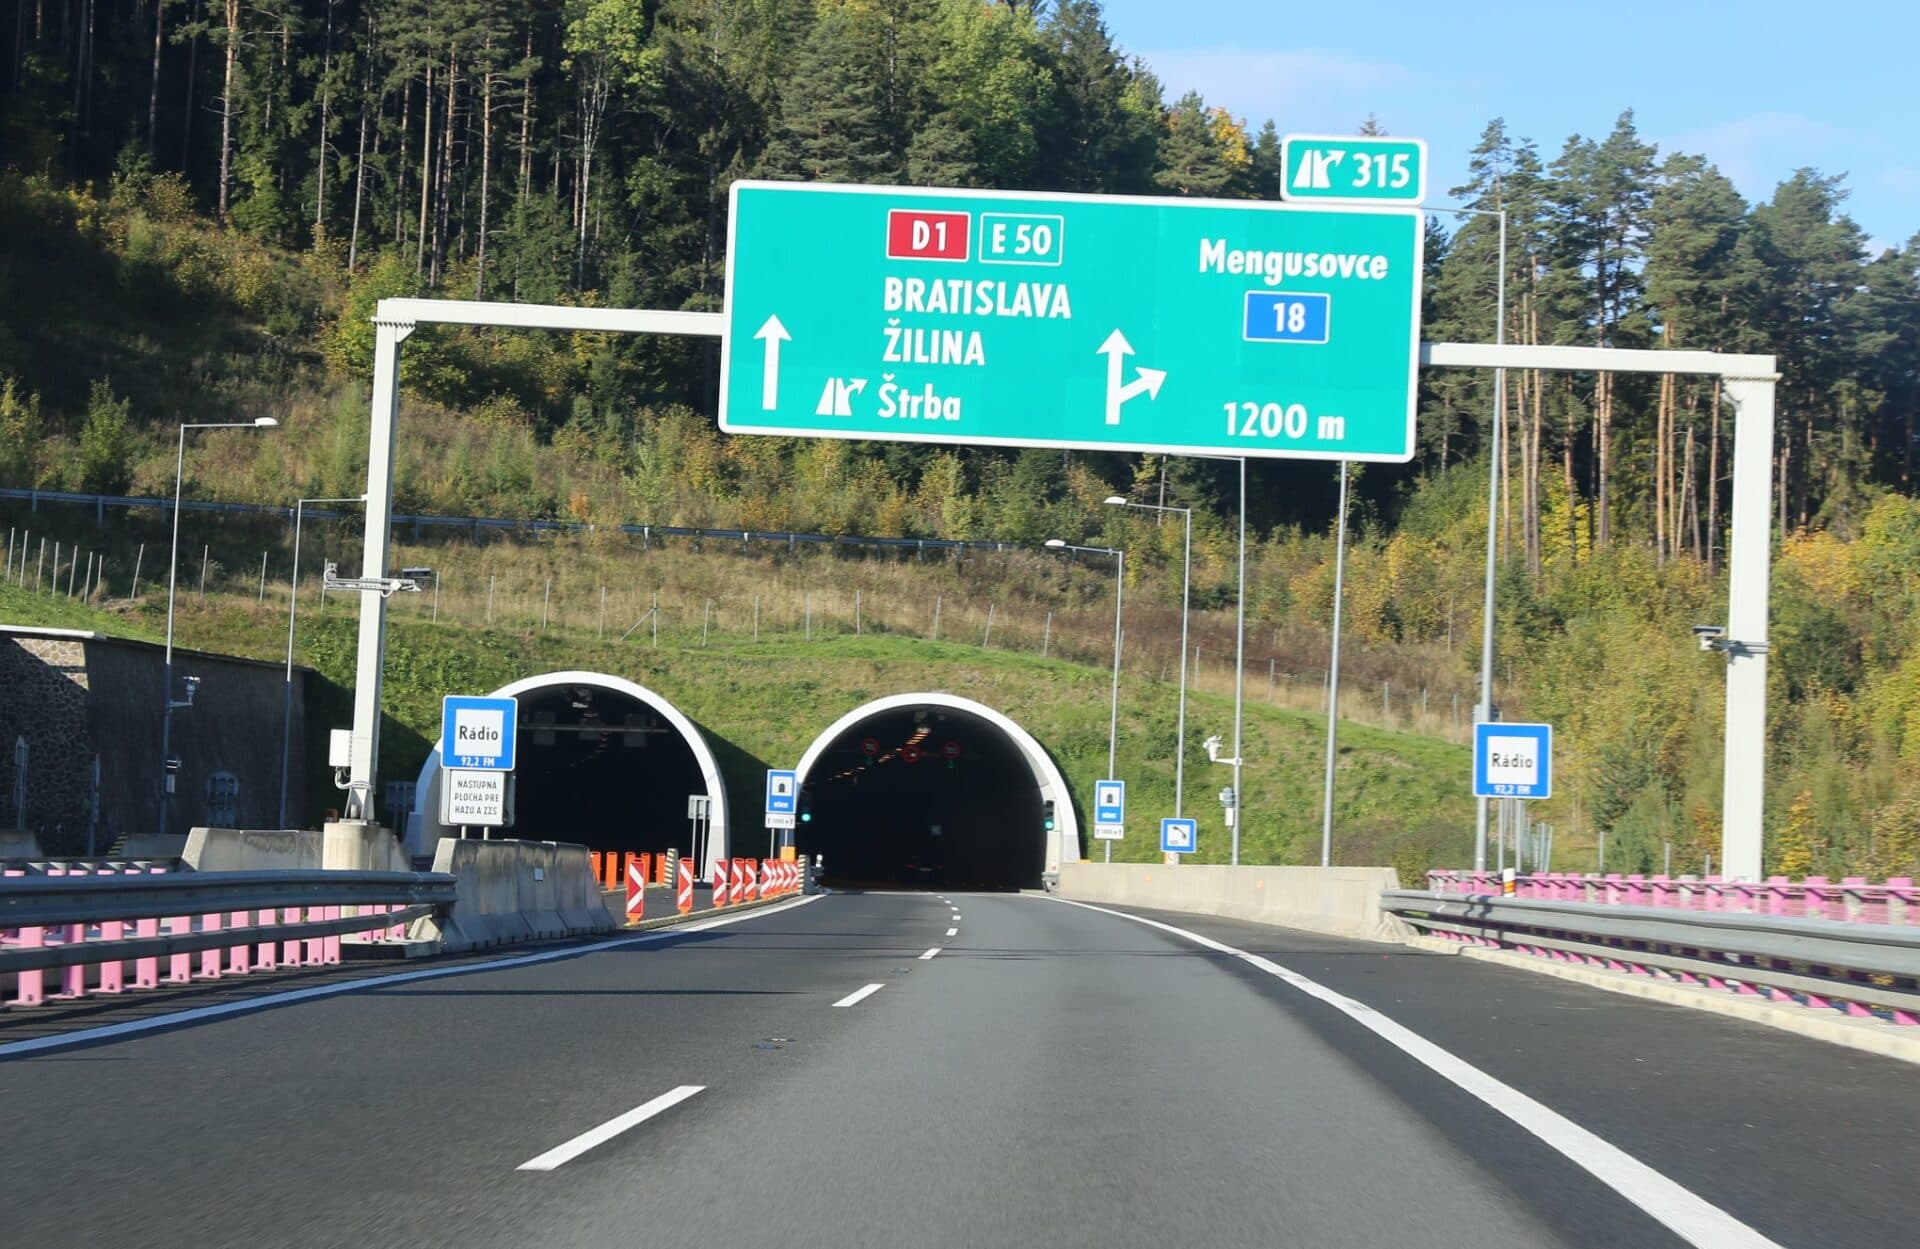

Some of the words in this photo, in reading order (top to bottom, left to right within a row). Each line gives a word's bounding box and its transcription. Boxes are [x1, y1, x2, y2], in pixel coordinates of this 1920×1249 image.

[1352, 152, 1410, 189] 315
[912, 219, 947, 252] D1
[991, 223, 1007, 254] E
[1014, 224, 1052, 256] 50
[1199, 238, 1389, 286] Mengusovce
[883, 276, 1072, 319] BRATISLAVA
[1272, 302, 1306, 333] 18
[882, 317, 986, 366] ŽILINA
[877, 372, 962, 421] Štrba
[1222, 401, 1308, 438] 1200
[1317, 415, 1345, 440] m
[458, 725, 499, 741] Rádio
[460, 757, 480, 768] 92,2
[483, 757, 496, 768] FM
[1491, 752, 1534, 769] Rádio
[454, 792, 483, 802] PLOCHA
[485, 793, 500, 803] PRE
[476, 806, 482, 815] A
